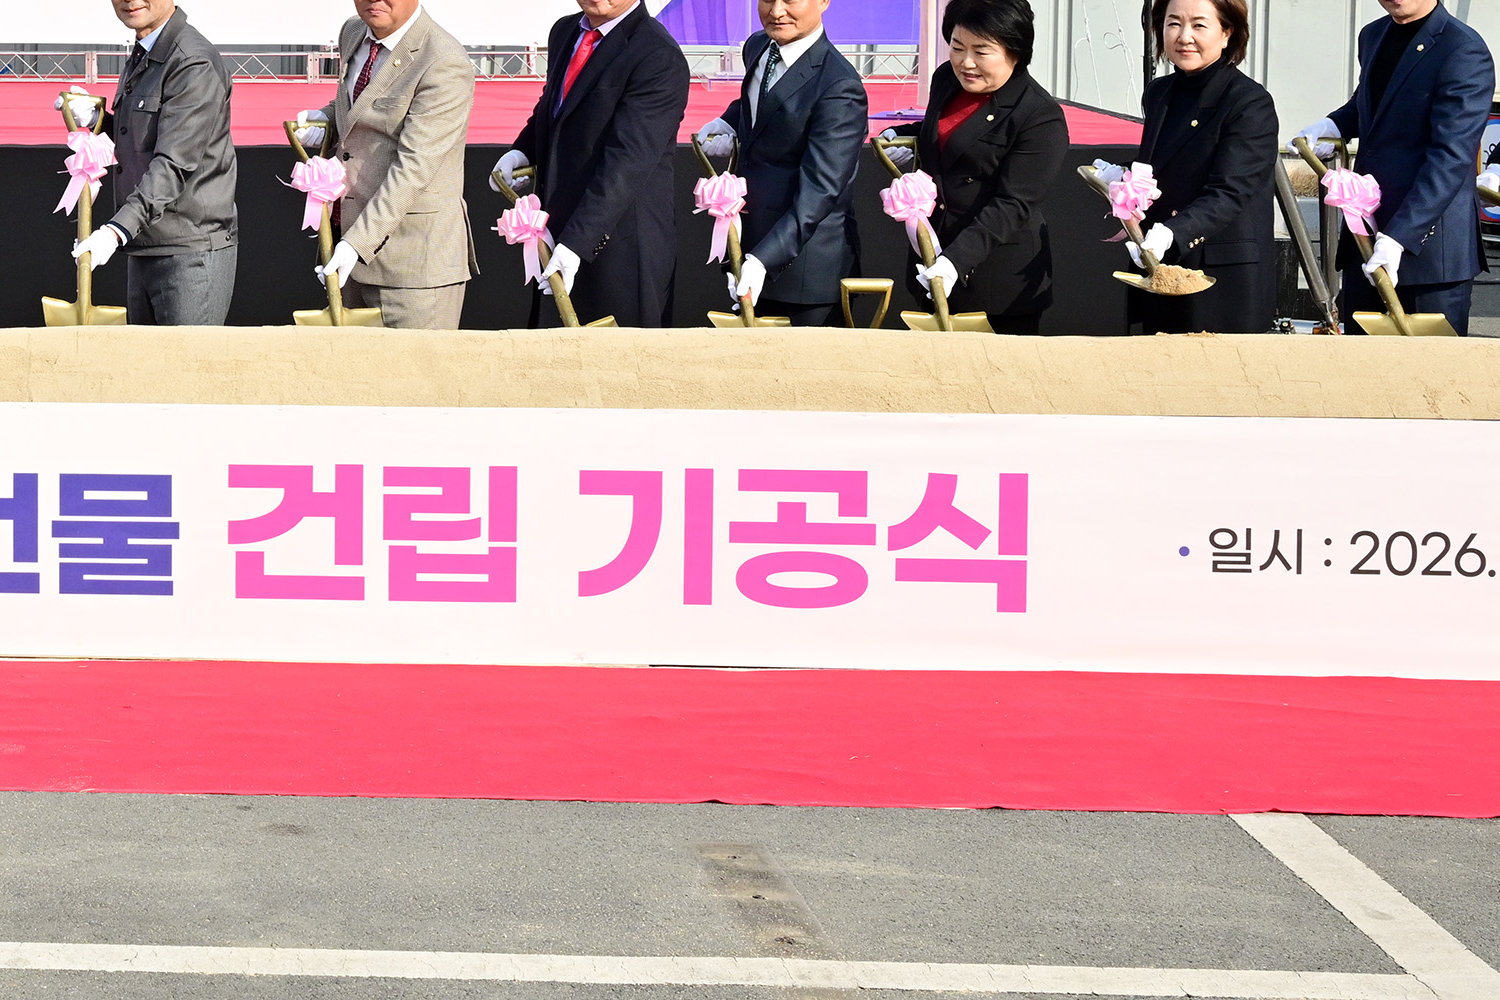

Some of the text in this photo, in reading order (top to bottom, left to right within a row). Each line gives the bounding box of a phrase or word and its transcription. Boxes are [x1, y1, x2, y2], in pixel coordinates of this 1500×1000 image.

[227, 463, 518, 603] 건립
[578, 468, 1029, 613] 기공식
[1208, 527, 1303, 575] 일시
[1349, 530, 1497, 578] 2026.
